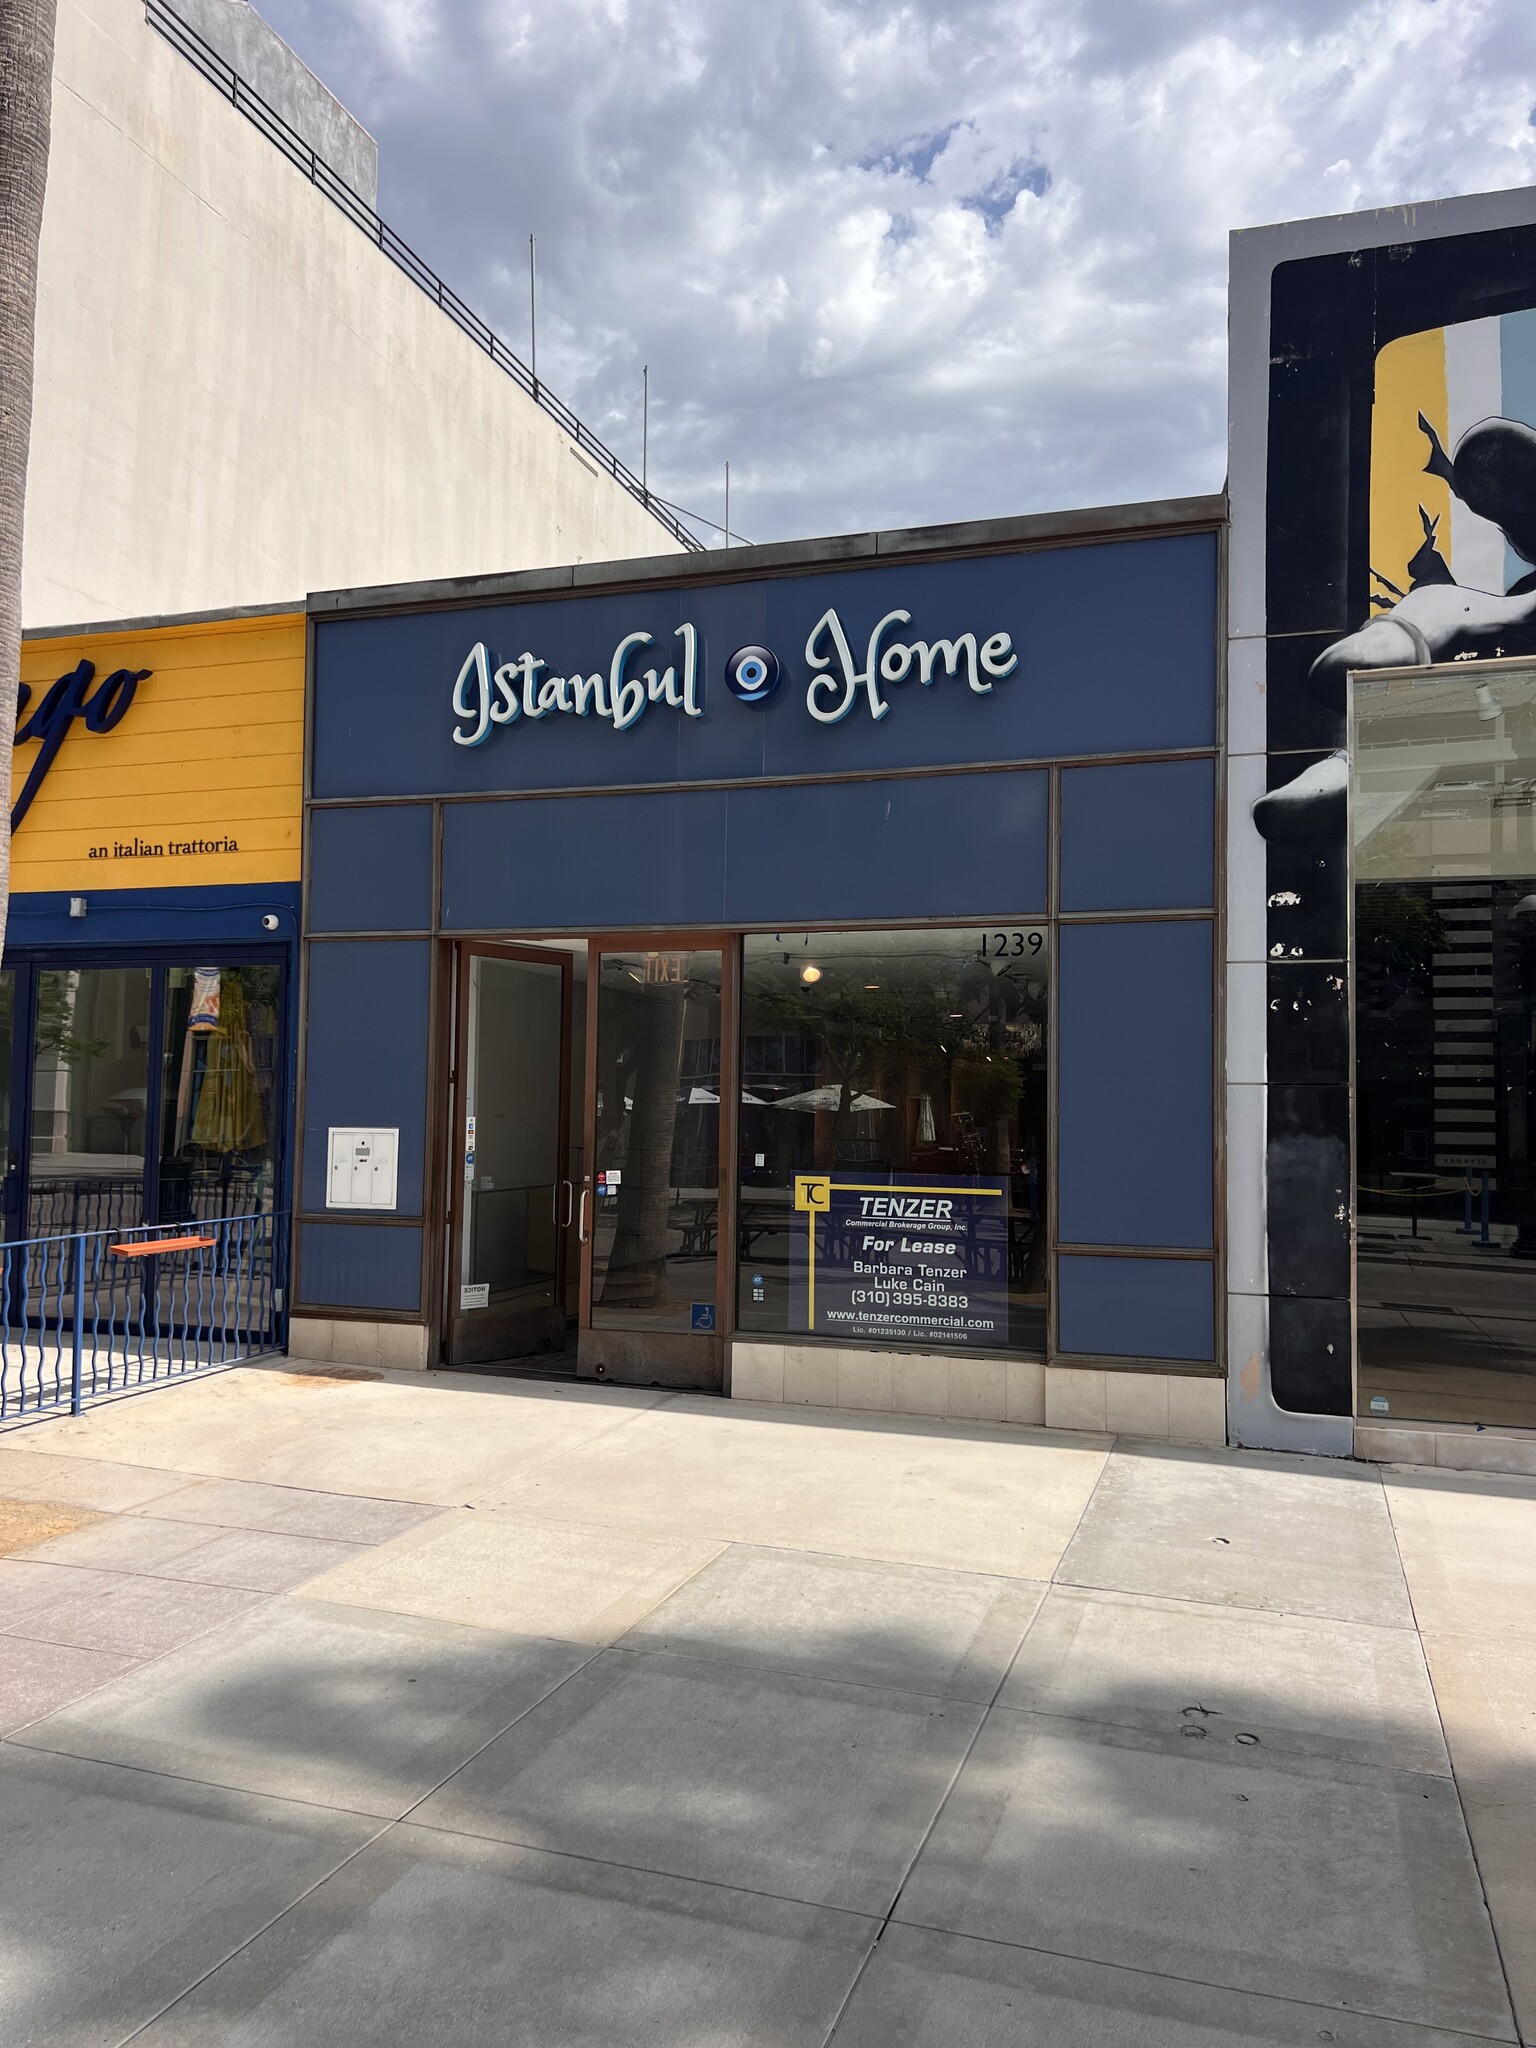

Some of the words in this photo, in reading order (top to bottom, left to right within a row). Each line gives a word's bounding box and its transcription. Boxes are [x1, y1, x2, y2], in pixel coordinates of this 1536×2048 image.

[452, 622, 703, 747] Istanbul
[804, 608, 1017, 725] Home
[88, 847, 108, 858] an
[113, 838, 164, 857] italian
[168, 836, 239, 855] trattoria
[982, 932, 1043, 957] 1239
[860, 1197, 953, 1219] TENZER
[845, 1219, 888, 1228] Commercial
[889, 1221, 926, 1230] Brokerage
[928, 1223, 953, 1231] Group,
[862, 1236, 895, 1251] For
[901, 1238, 957, 1255] Lease
[853, 1261, 913, 1276] Barbara
[918, 1264, 967, 1278] Tenzer
[874, 1277, 908, 1290] Luke
[913, 1279, 945, 1292] Cain
[851, 1290, 890, 1307] (310)
[892, 1292, 969, 1308] 395-8383
[827, 1310, 994, 1329] www.tenzercommercial.com
[852, 1326, 866, 1334] Lic.
